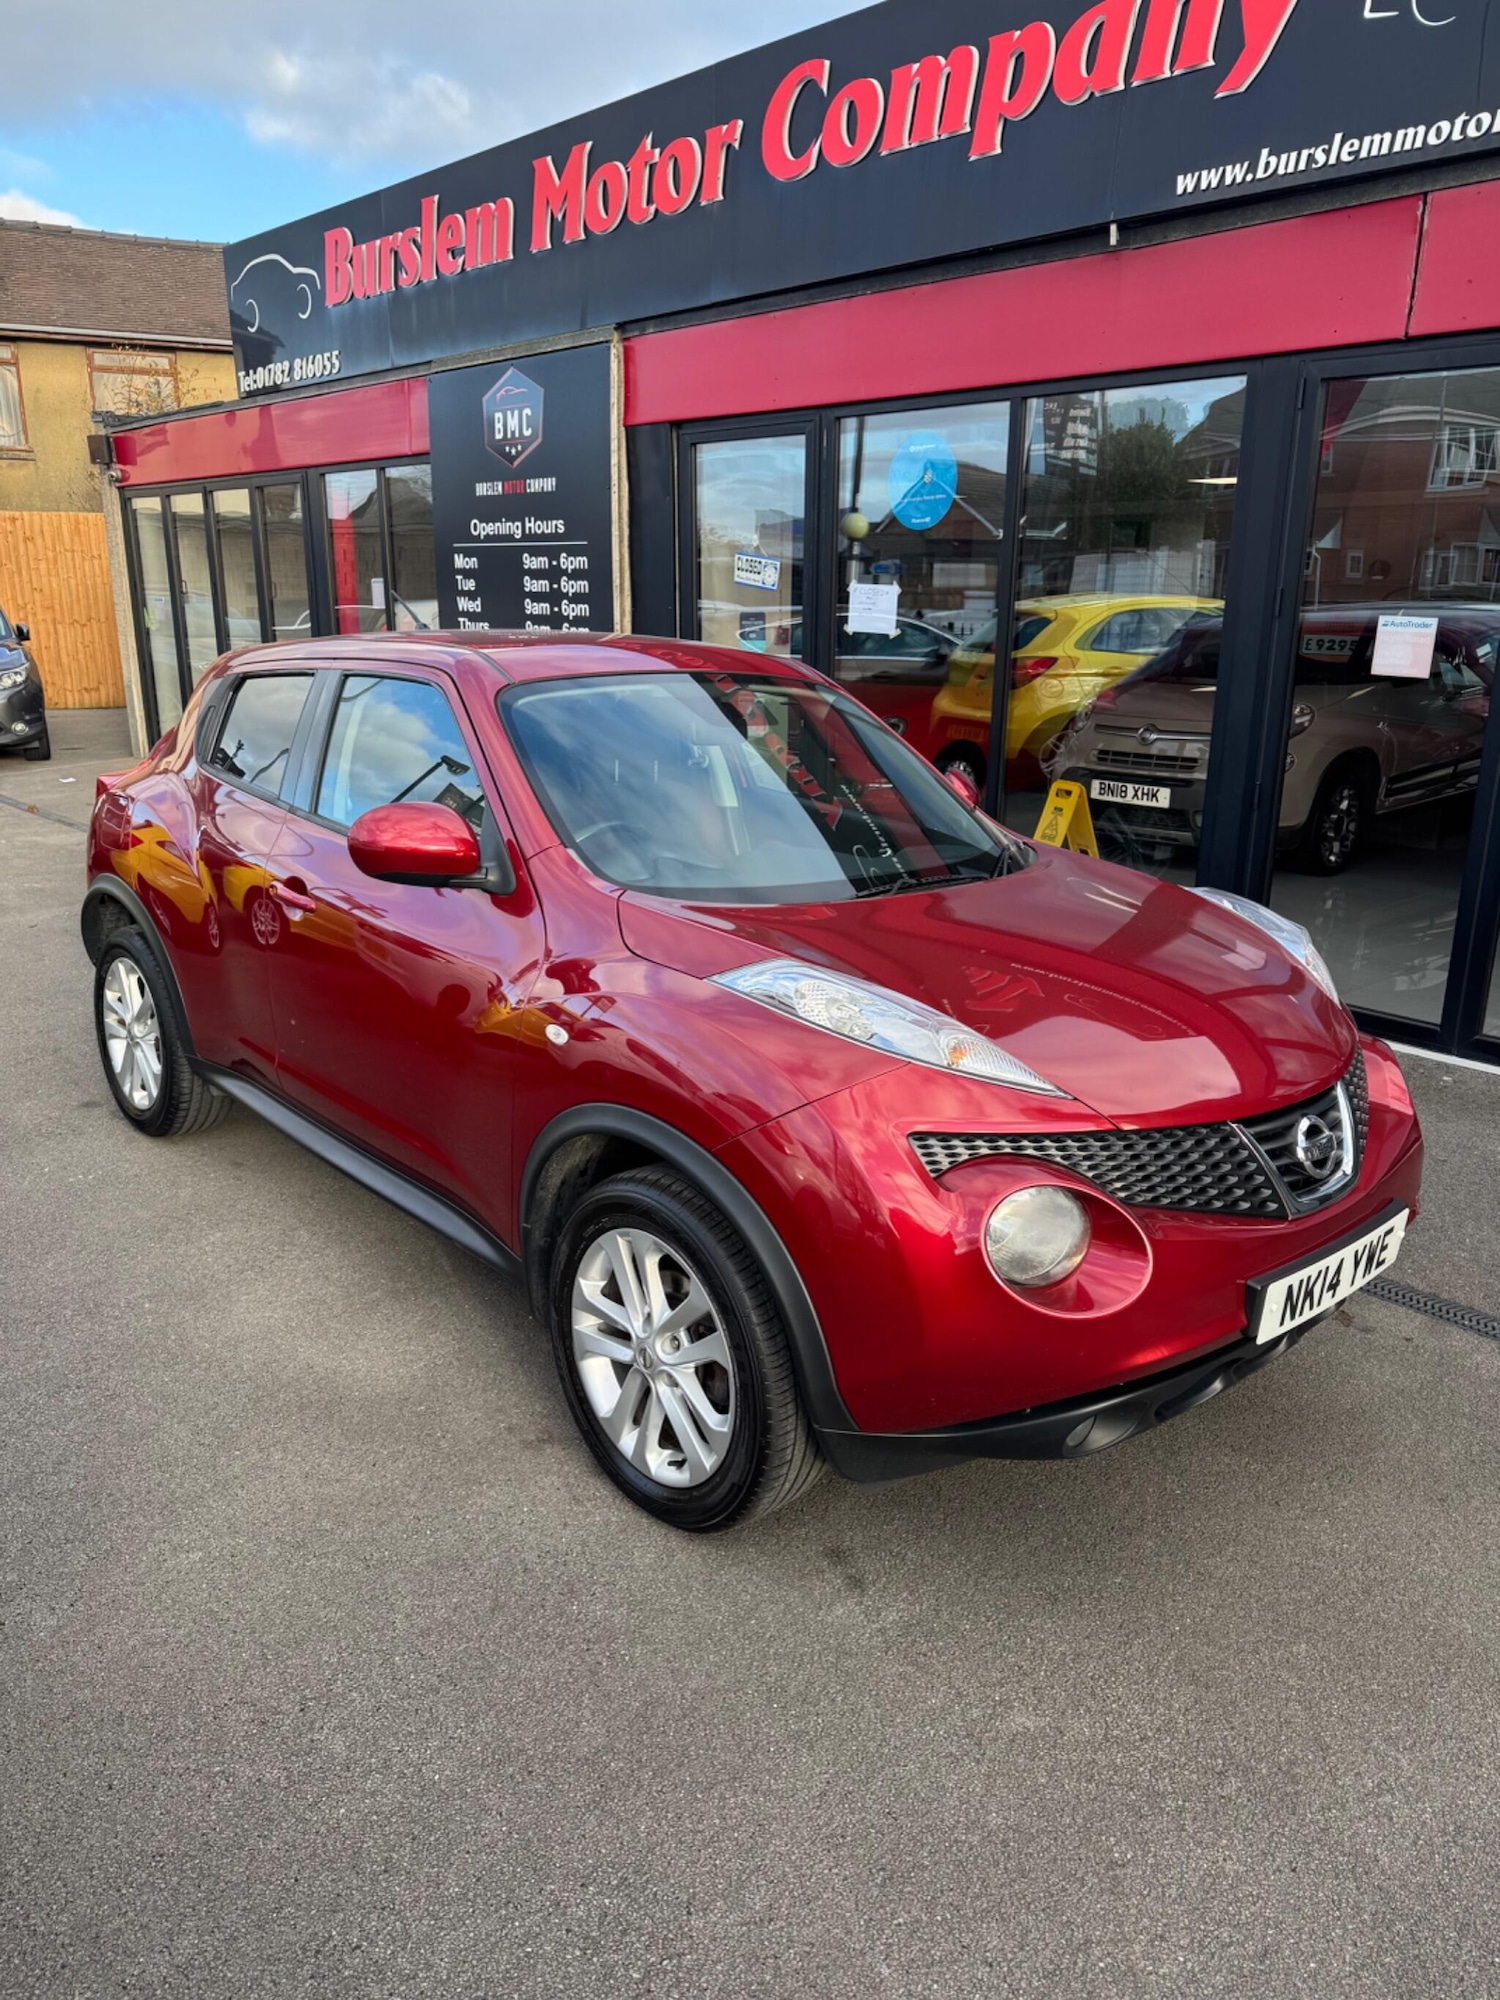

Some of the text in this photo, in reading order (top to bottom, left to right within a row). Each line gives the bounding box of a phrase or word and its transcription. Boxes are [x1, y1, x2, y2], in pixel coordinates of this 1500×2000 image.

[324, 0, 1297, 308] Burslem Motor Company
[238, 350, 341, 392] Tel:01782 816055
[494, 407, 532, 439] BMC
[470, 516, 565, 539] Opening Hours
[454, 553, 478, 569] Mon
[522, 553, 549, 569] 9am
[560, 552, 588, 574] 6pm
[737, 556, 762, 575] CLOSED
[455, 575, 476, 591] Tue
[523, 576, 550, 592] 9am
[560, 576, 589, 597] 6pm
[457, 596, 482, 612] Wed
[524, 598, 550, 615] 9am
[561, 599, 590, 620] 6pm
[1390, 620, 1433, 629] AutoTrader
[1099, 781, 1161, 803] BN18 XHK
[1279, 1226, 1395, 1327] NK14 YWE
